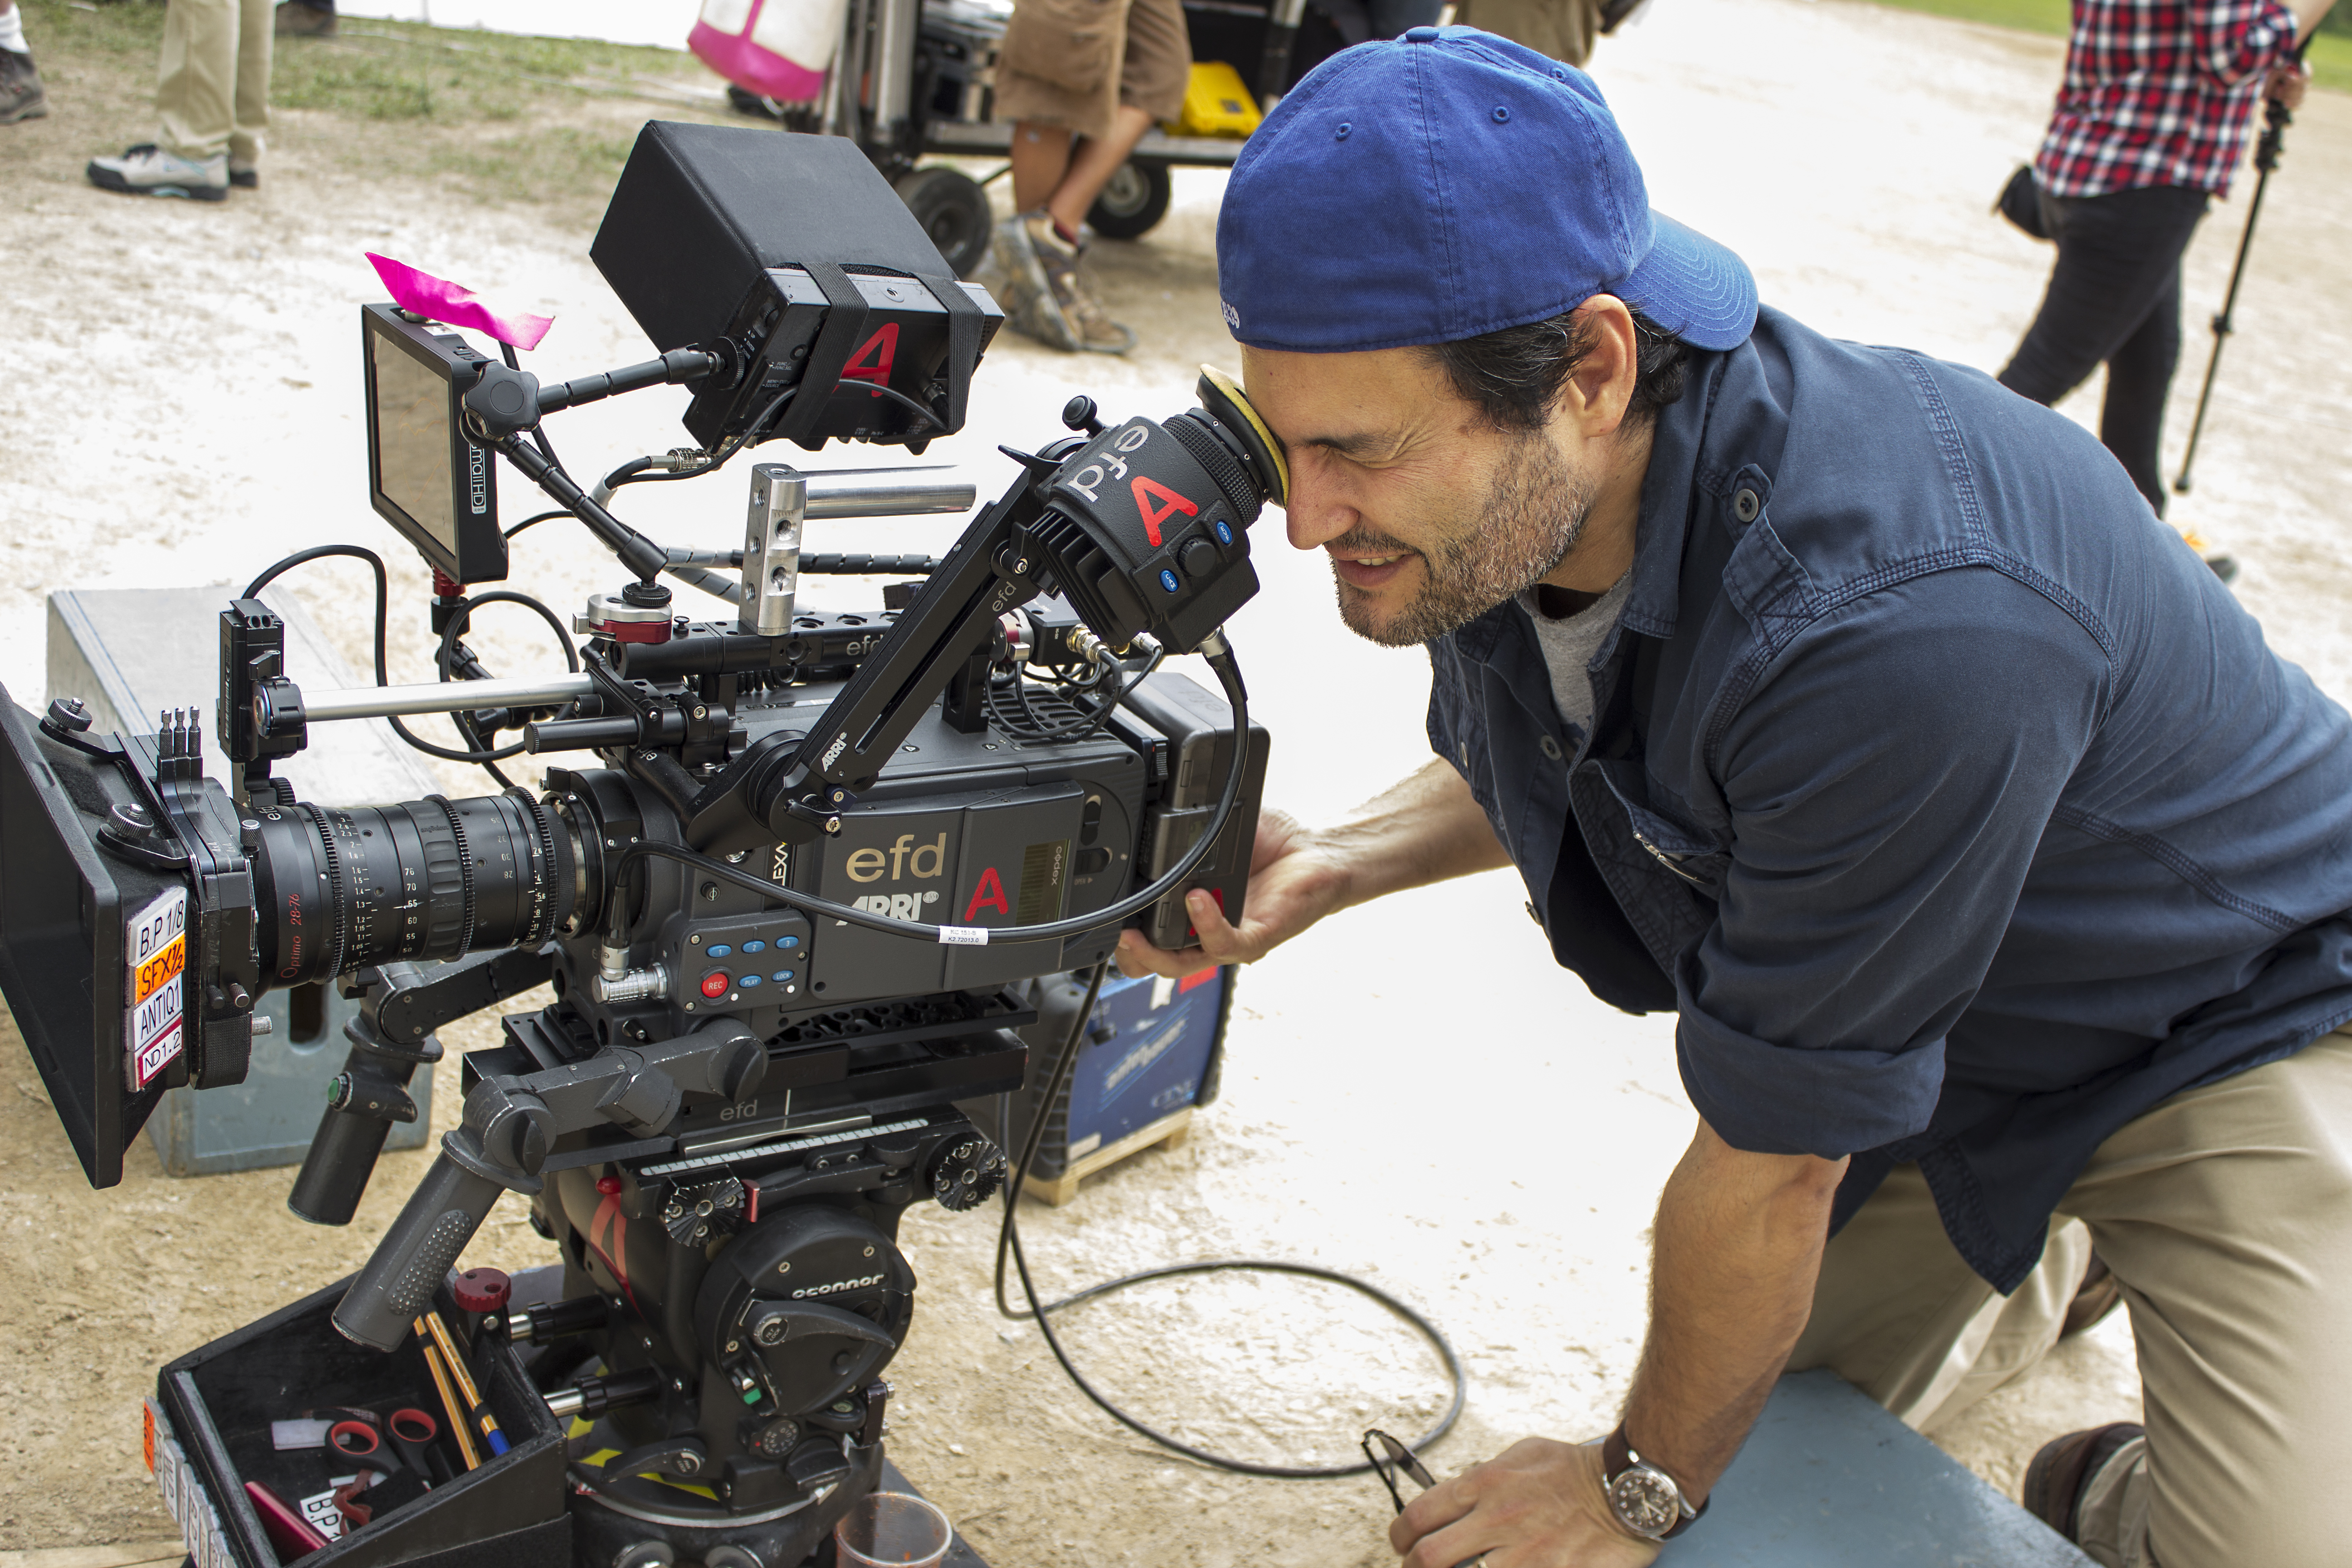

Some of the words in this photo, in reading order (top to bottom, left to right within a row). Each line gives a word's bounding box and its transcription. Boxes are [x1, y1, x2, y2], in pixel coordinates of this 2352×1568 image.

[832, 323, 899, 397] A
[1067, 425, 1149, 502] efd
[1131, 476, 1198, 547] A
[1220, 525, 1230, 541] EVF
[992, 581, 1017, 612] efd
[1166, 574, 1176, 589] CAM
[822, 739, 847, 772] ARRI
[256, 806, 281, 820] efd
[846, 833, 946, 882] efd
[407, 883, 416, 891] 70
[504, 871, 513, 879] 28
[289, 893, 302, 925] 28-76
[965, 867, 1009, 921] A
[140, 916, 163, 958] B.P
[167, 900, 184, 936] 1/8
[280, 936, 302, 978] Optimo
[708, 981, 722, 990] REC
[141, 980, 180, 1040] ANTIQ1
[720, 1099, 757, 1121] efd
[792, 1274, 884, 1299] oconnor
